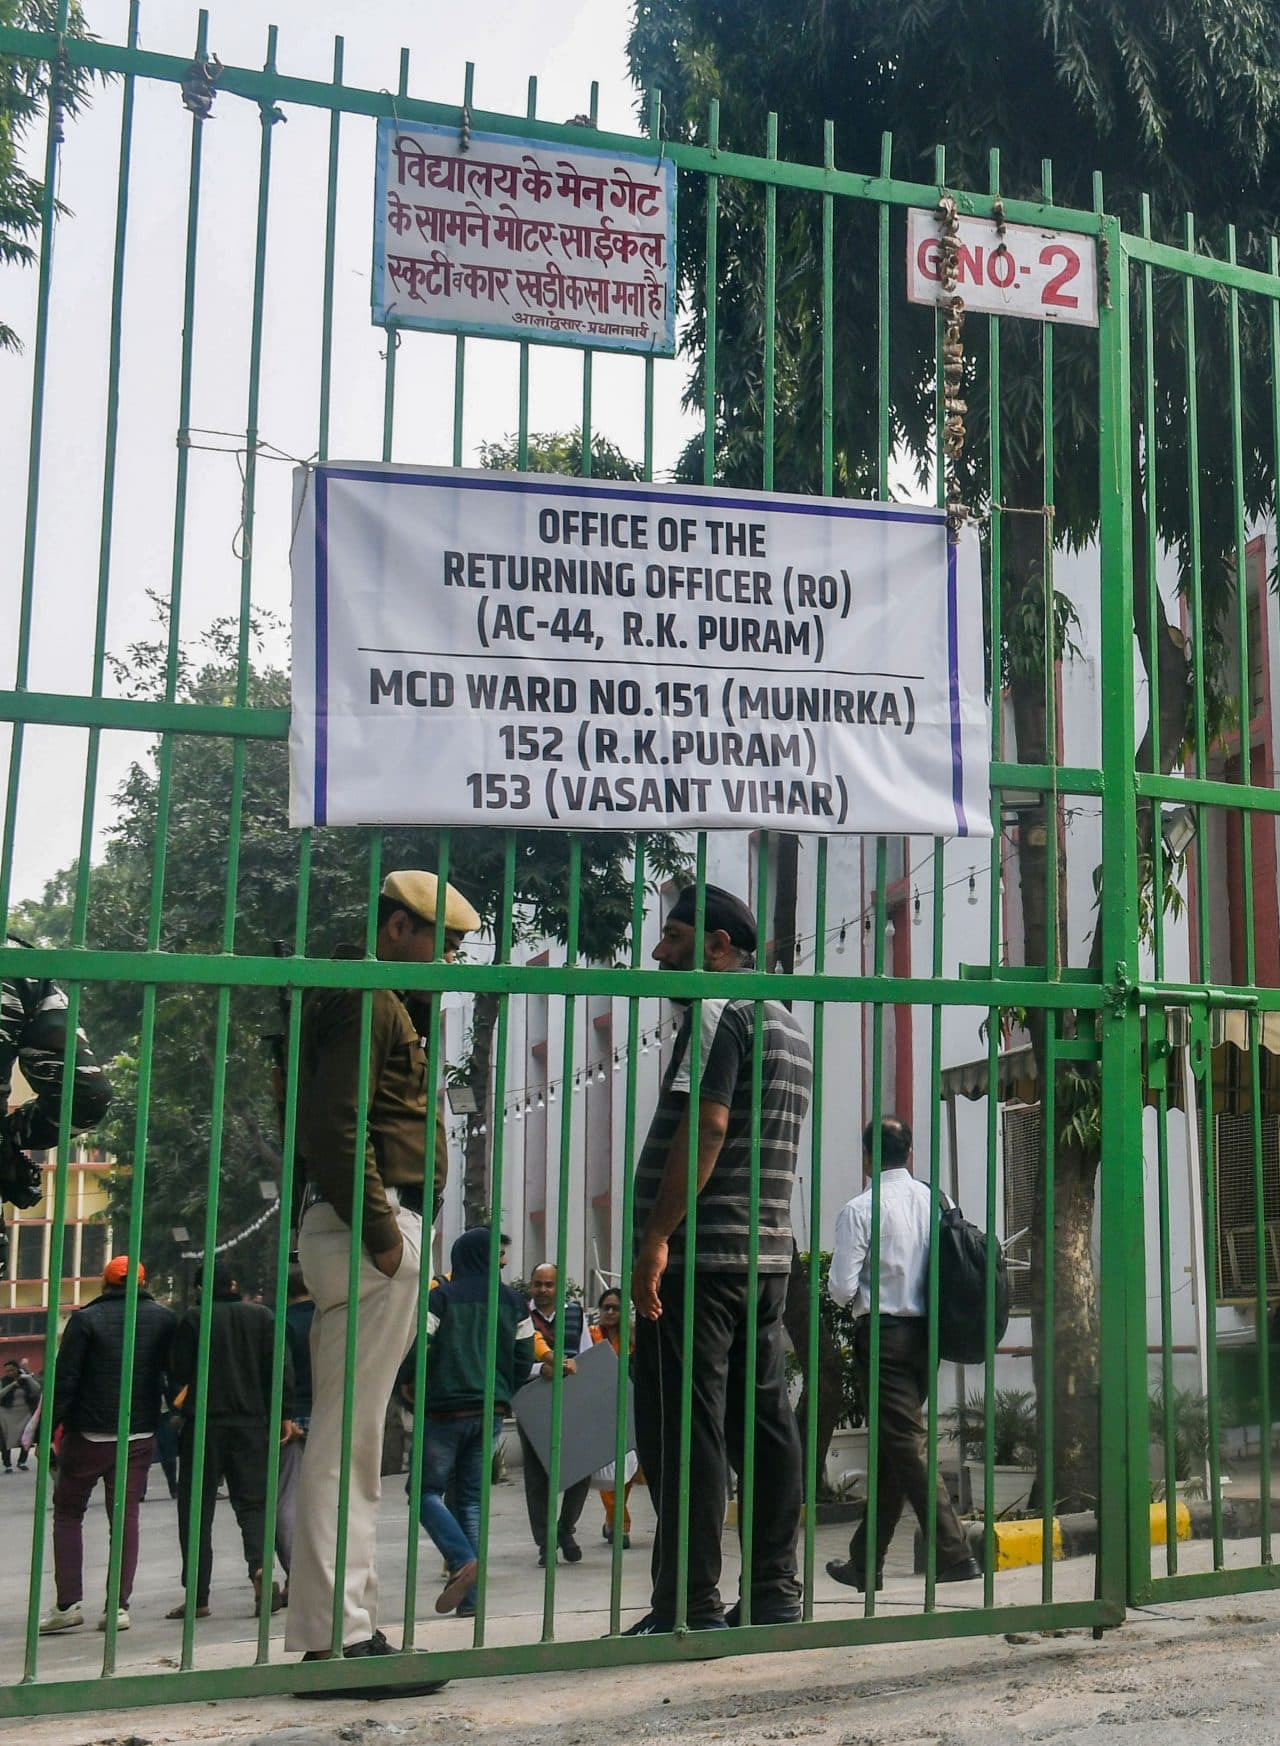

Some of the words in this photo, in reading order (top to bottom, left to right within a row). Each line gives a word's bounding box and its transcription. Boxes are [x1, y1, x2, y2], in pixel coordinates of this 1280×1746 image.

[392, 136, 522, 201] विद्यालय
[522, 156, 552, 203] के
[556, 161, 608, 212] मेन
[610, 168, 662, 216] गेट
[388, 191, 415, 235] के
[415, 201, 491, 249] सामने
[462, 264, 512, 304] कार
[613, 280, 648, 318] मना
[539, 507, 648, 550] OFFICE
[658, 516, 699, 553] OF
[706, 521, 766, 558] THE
[444, 552, 635, 597] RETURNING
[646, 564, 772, 606] OFFICER
[784, 566, 851, 619] (RO)
[477, 595, 603, 648] (AC-44,
[623, 615, 687, 650] R.K.
[700, 614, 825, 663] PURAM)
[370, 668, 455, 708] MCD
[467, 674, 574, 714] WARD
[590, 679, 709, 718] NO.151
[723, 678, 915, 734] (MUNIRKA)
[500, 726, 563, 761] 152
[578, 720, 817, 775] (R.K.PURAM)
[467, 773, 531, 809] 153
[547, 768, 715, 820] (VASANT
[724, 775, 849, 824] VIHAR)
